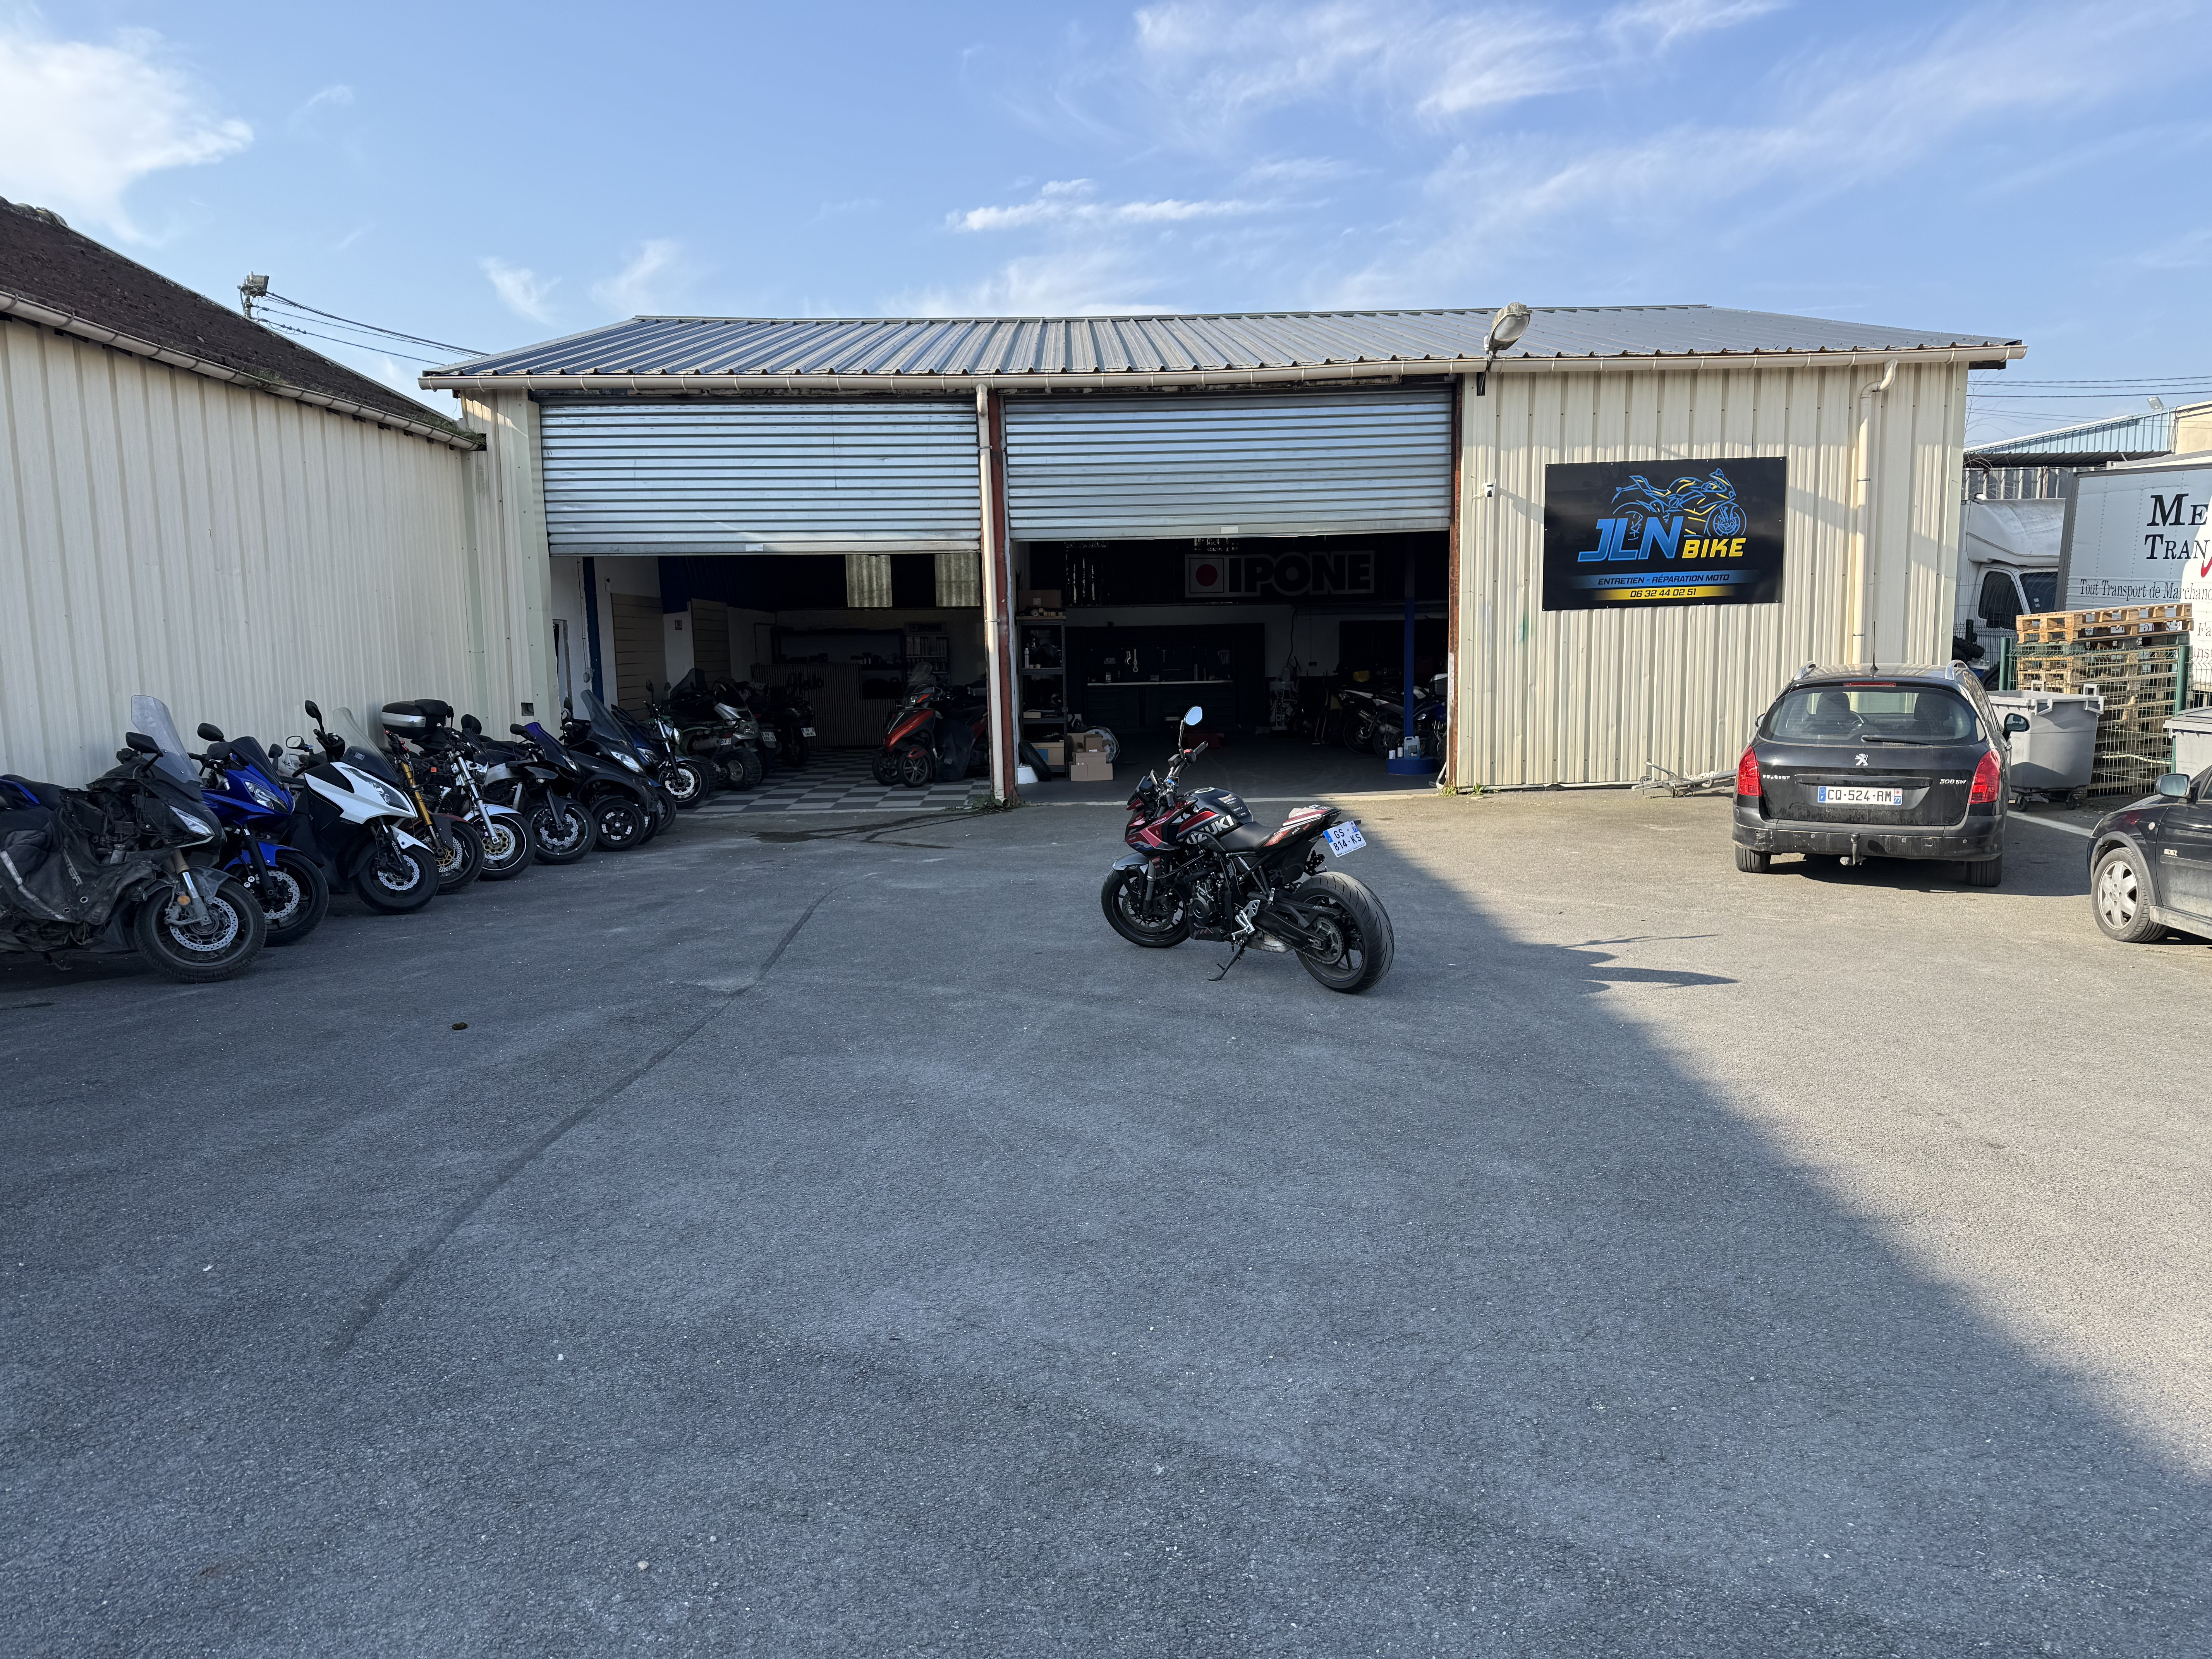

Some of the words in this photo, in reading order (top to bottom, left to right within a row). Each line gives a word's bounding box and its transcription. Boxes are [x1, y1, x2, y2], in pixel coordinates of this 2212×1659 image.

[2147, 493, 2209, 526] ME
[1577, 516, 1684, 562] JLN
[1682, 538, 1746, 558] BIKE
[2144, 534, 2210, 559] TRAN
[1229, 554, 1370, 592] IPONE
[1598, 577, 1644, 585] ENTRETIEN
[1652, 574, 1704, 583] RÉPARATION
[2080, 579, 2099, 595] Tout
[2102, 580, 2146, 601] Transport
[2150, 582, 2160, 598] de
[1828, 789, 1891, 802] CQ-524-RM
